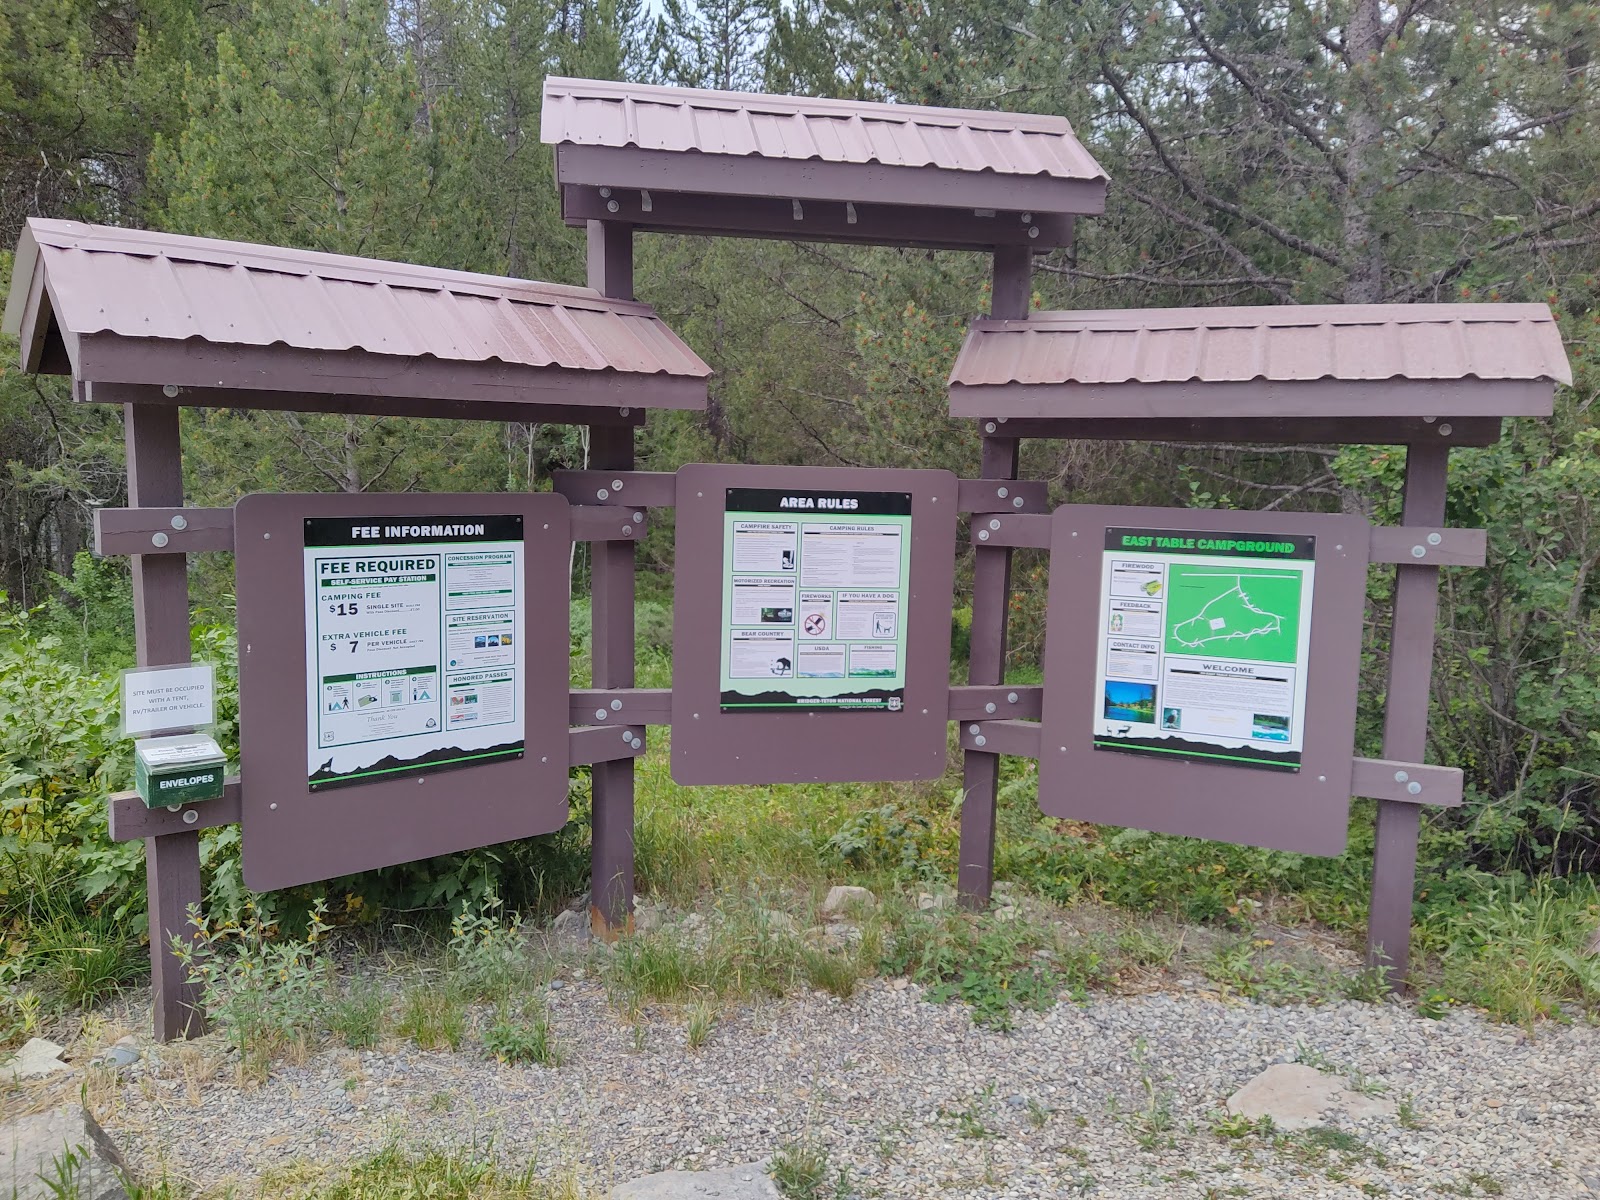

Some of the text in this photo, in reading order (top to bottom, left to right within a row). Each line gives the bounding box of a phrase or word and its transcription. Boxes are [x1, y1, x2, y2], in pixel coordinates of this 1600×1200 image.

[780, 497, 858, 509] AREA RULES
[352, 524, 484, 538] FEE INFORMATION
[1122, 536, 1295, 554] EAST TABLE CAMPGROUND
[321, 562, 350, 574] FEE
[356, 559, 435, 573] REQUIRED
[330, 577, 382, 586] SELF-SERVICE
[384, 576, 397, 584] PAY
[322, 593, 363, 602] CAMPING
[329, 603, 358, 616] $15
[322, 633, 350, 641] EXTRA
[353, 630, 389, 638] VEHICLE
[330, 641, 358, 653] $ 7
[1202, 663, 1254, 674] WELCOME
[356, 669, 407, 680] INSTRUCTIONS
[453, 674, 483, 682] HONORED
[133, 706, 168, 715] RV/TRAILER
[160, 774, 214, 789] ENVELOPES
